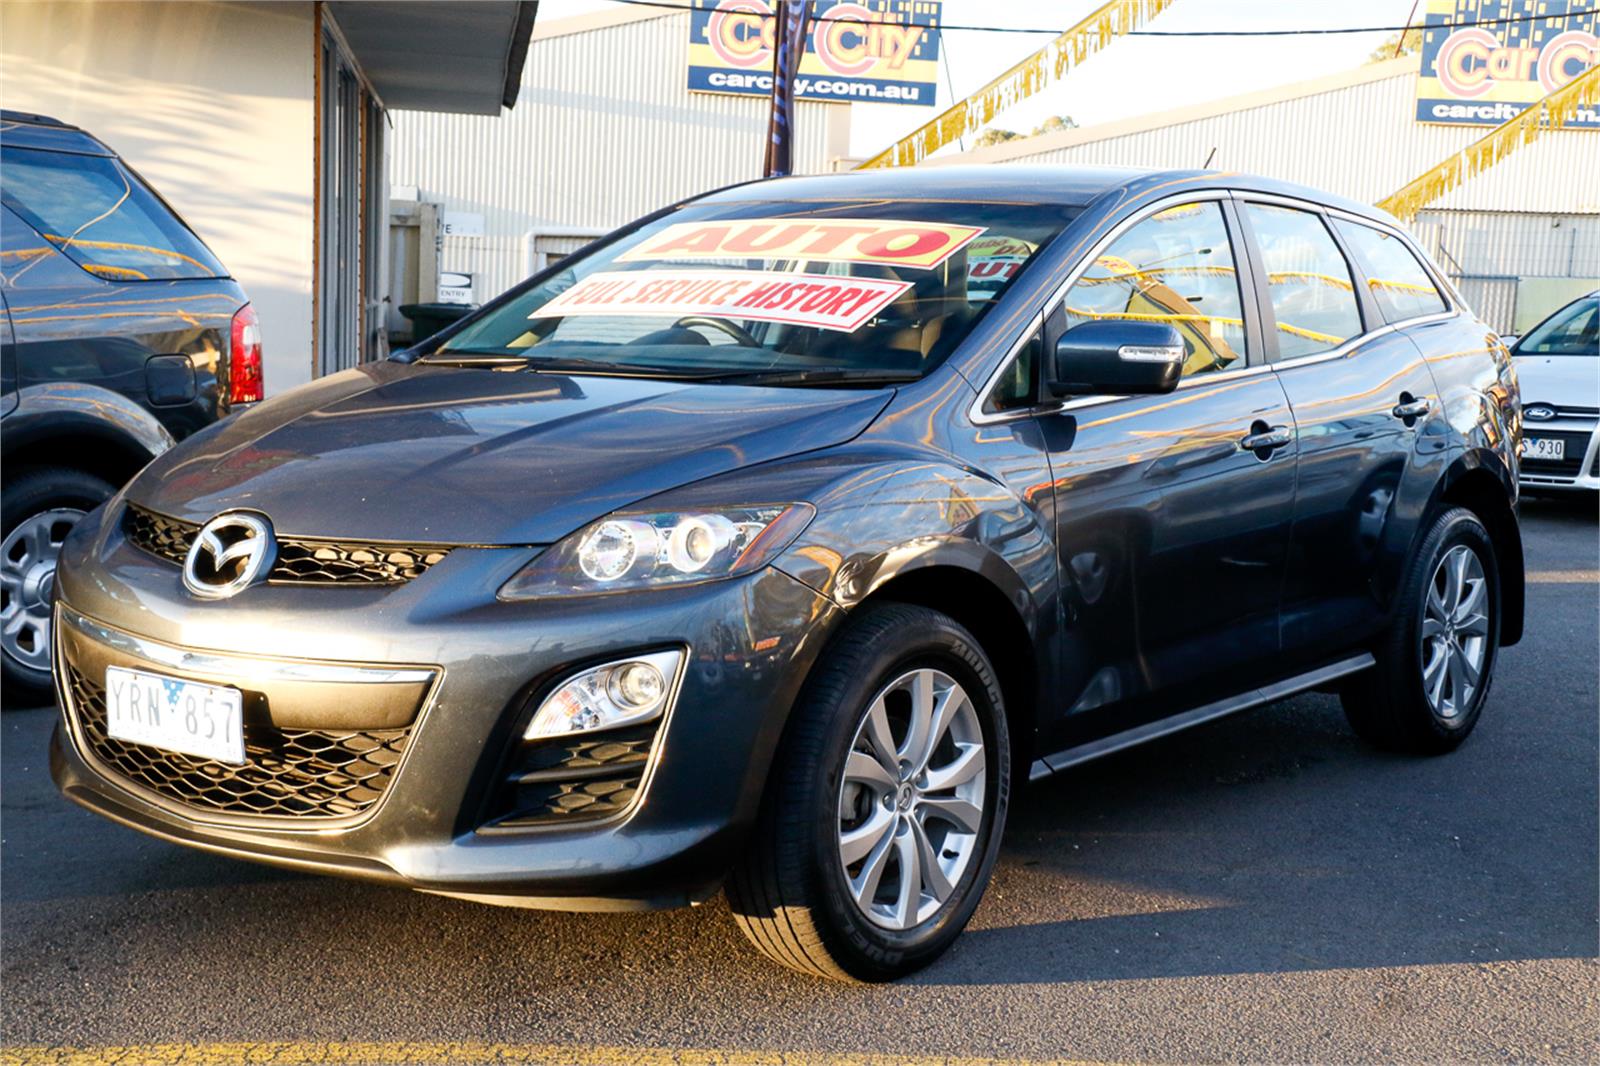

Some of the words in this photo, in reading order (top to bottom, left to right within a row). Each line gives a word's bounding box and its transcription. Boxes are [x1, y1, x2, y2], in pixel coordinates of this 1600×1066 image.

[813, 2, 924, 76] City
[1436, 28, 1539, 99] Car
[708, 72, 920, 100] carcy.com.au
[645, 224, 950, 258] AUTO
[967, 262, 1021, 278] UT
[560, 280, 634, 305] FULL
[625, 279, 751, 306] SERVICE
[734, 282, 887, 317] HISTORY
[1538, 441, 1563, 455] 930
[111, 679, 161, 727] YRN
[185, 695, 233, 743] 857
